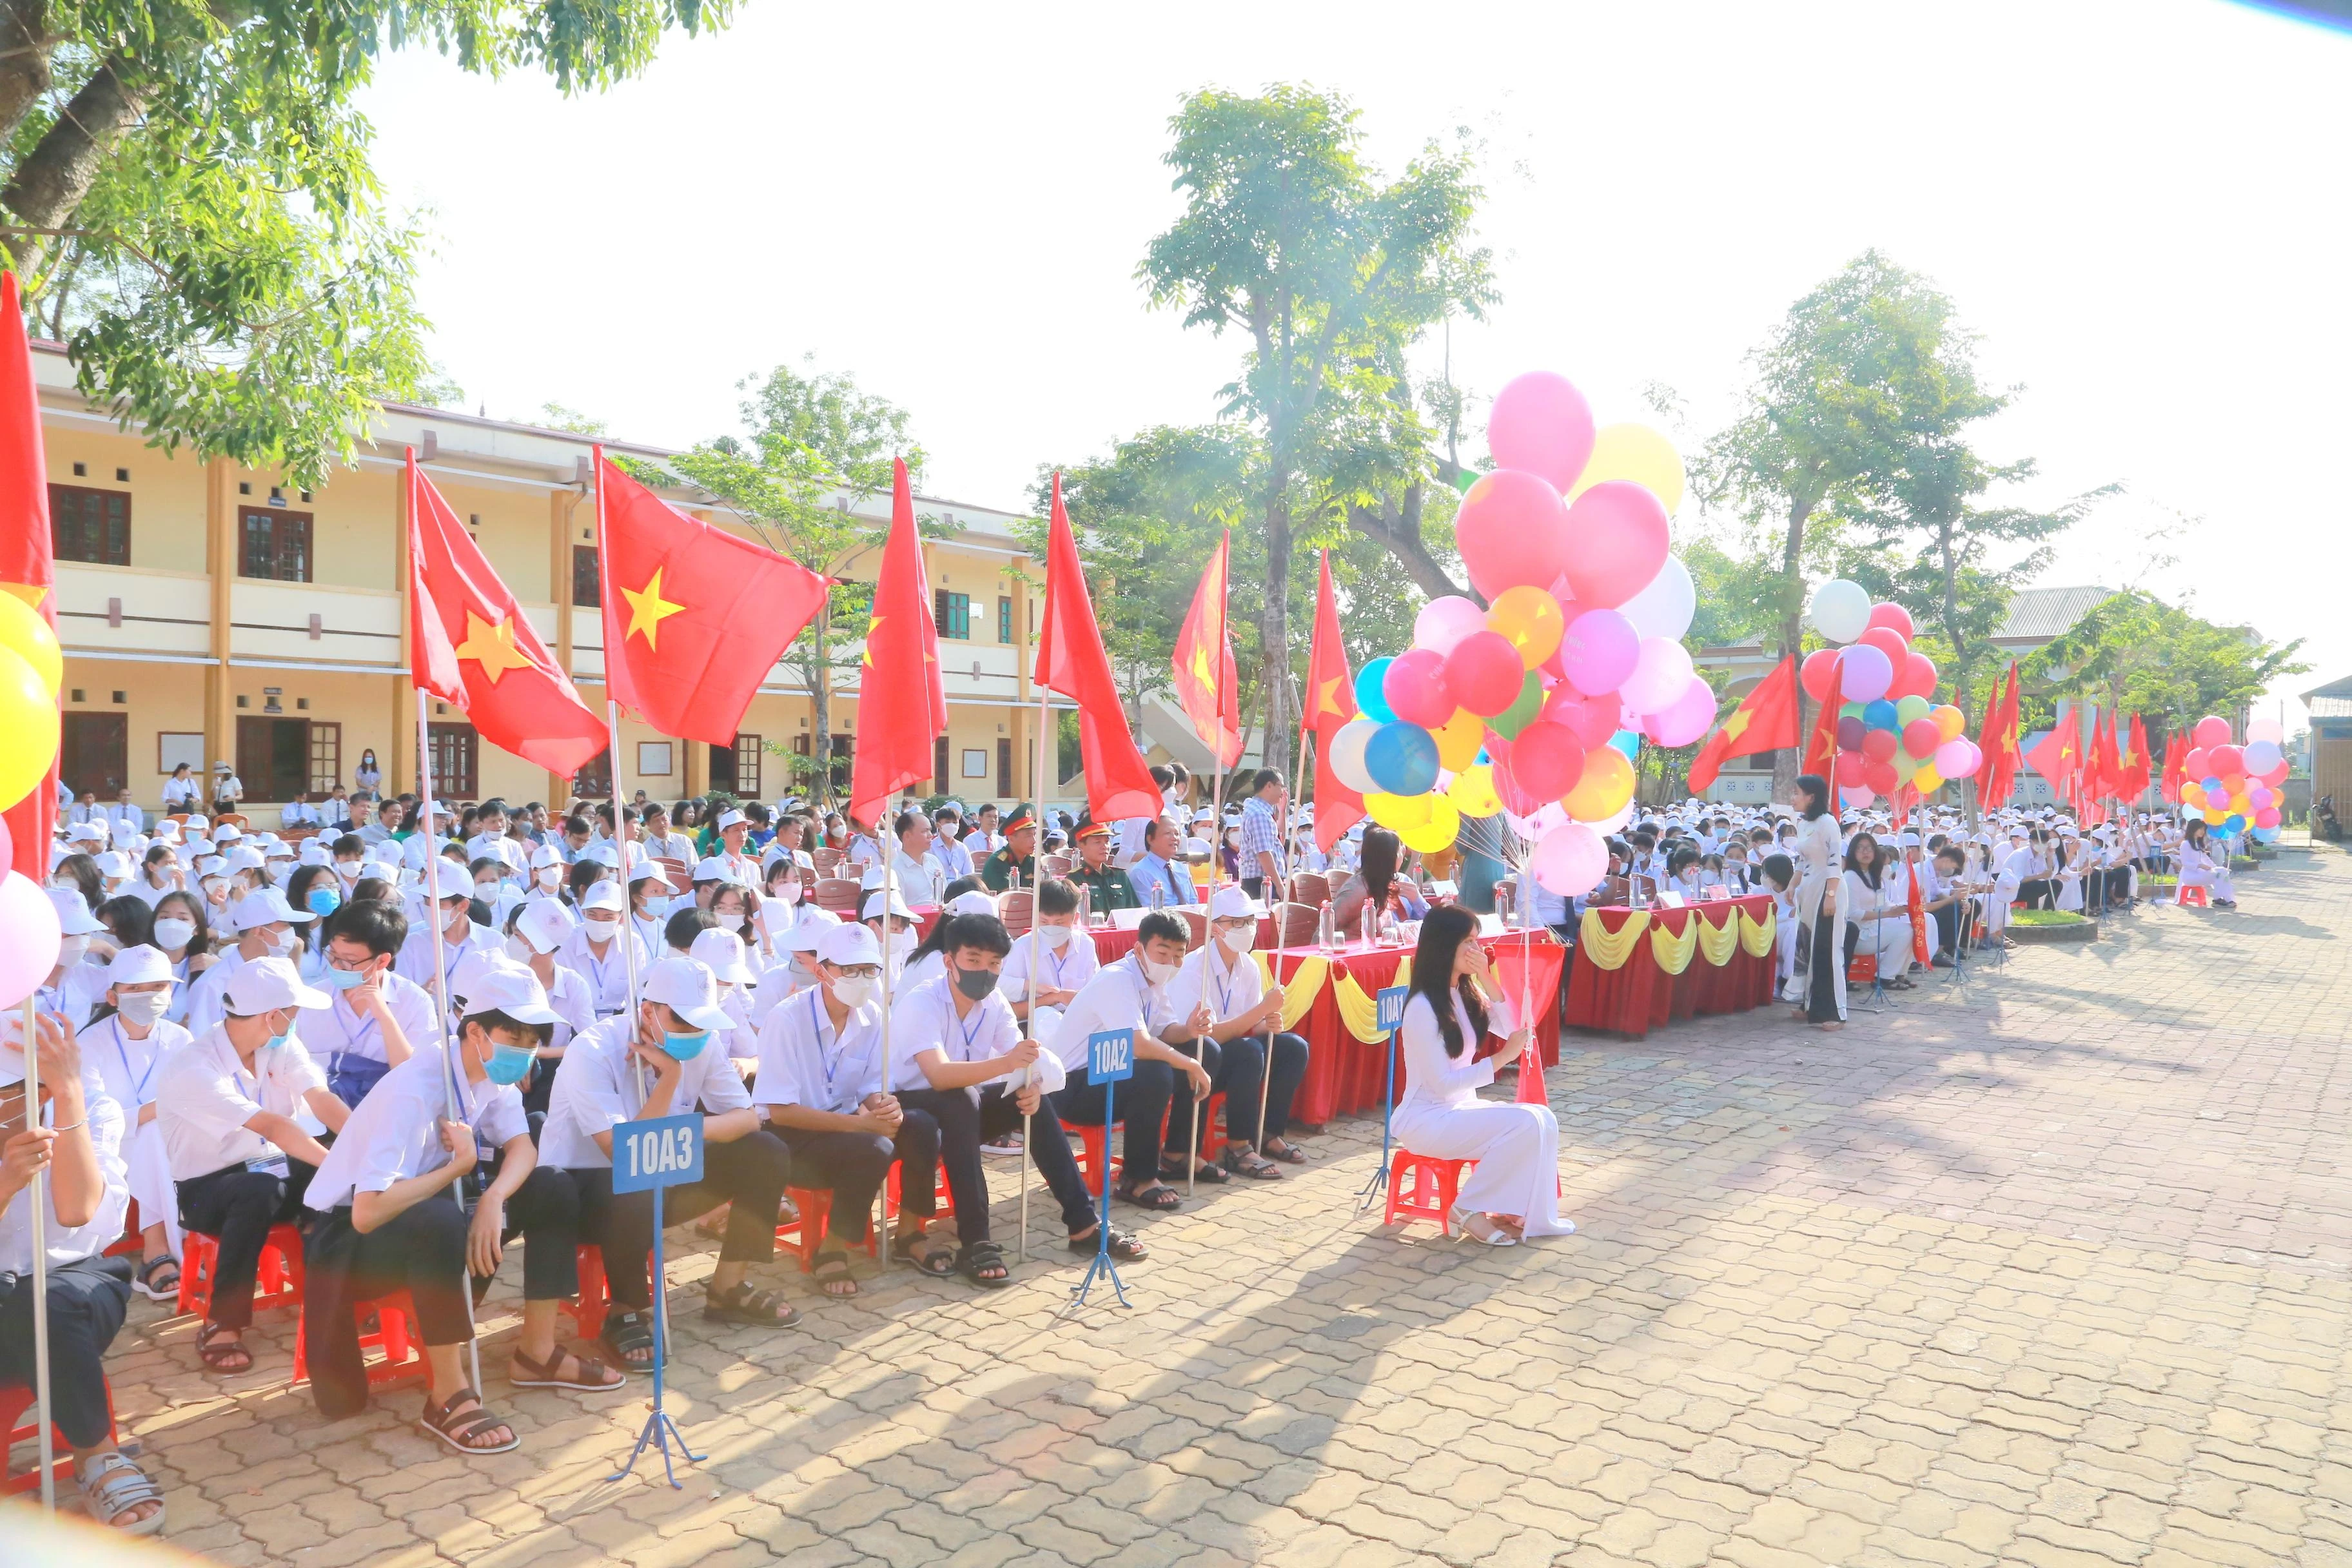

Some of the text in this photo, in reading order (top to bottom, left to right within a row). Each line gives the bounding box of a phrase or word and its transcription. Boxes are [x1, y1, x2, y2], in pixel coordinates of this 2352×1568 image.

[1381, 994, 1403, 1024] 10A1
[1095, 1037, 1128, 1074] 10A2
[627, 1126, 692, 1177] 10A3
